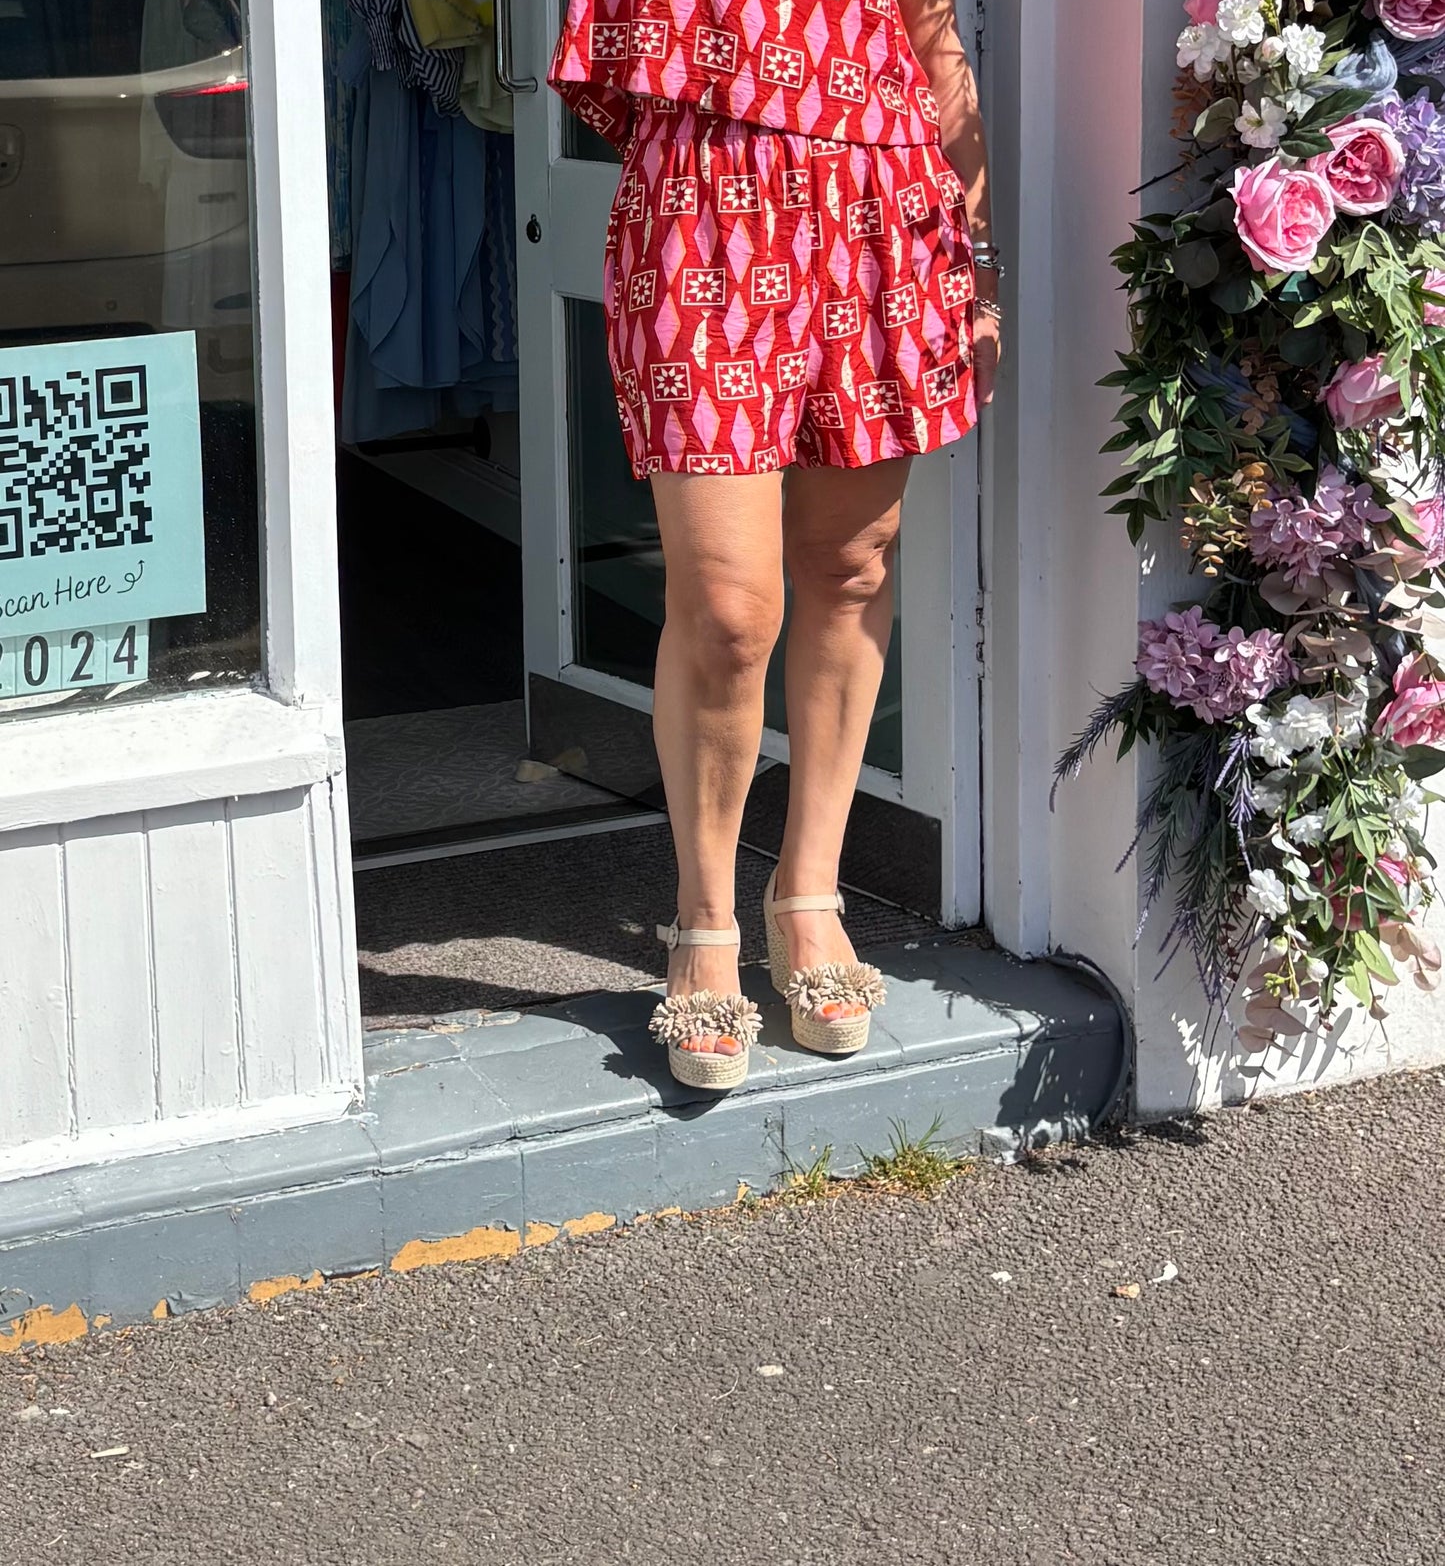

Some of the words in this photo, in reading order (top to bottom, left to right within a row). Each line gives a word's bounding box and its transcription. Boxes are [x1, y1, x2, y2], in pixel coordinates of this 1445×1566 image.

[0, 591, 50, 618] can
[55, 575, 112, 606] Here
[0, 625, 139, 688] 024
